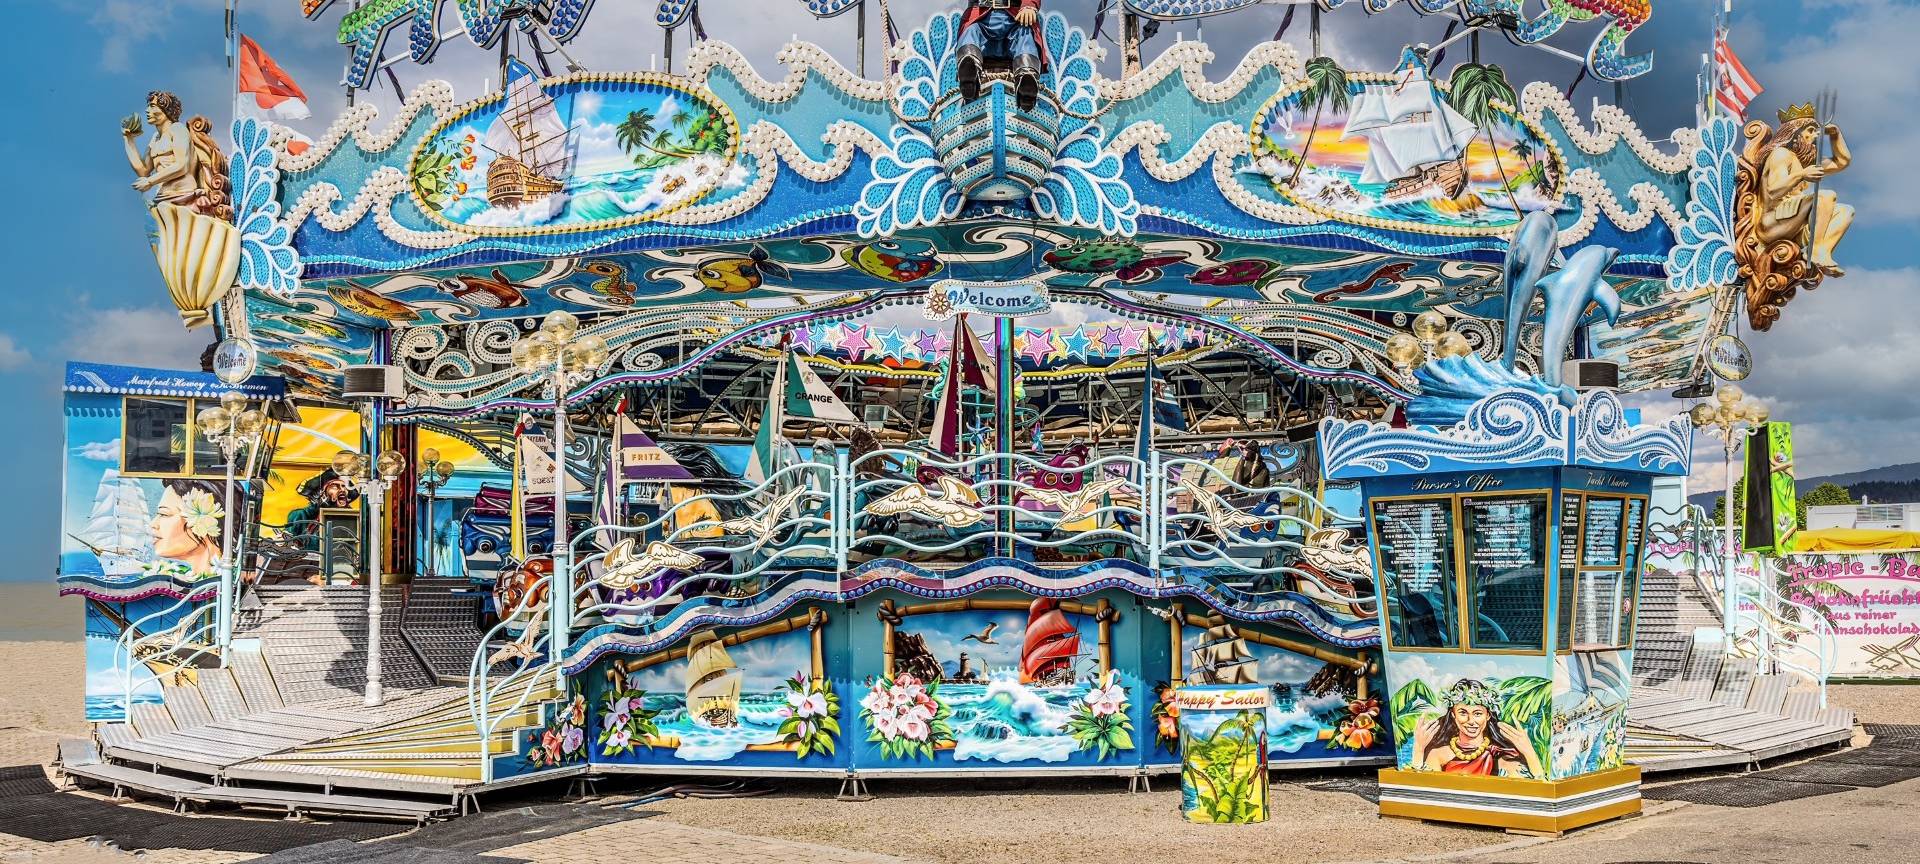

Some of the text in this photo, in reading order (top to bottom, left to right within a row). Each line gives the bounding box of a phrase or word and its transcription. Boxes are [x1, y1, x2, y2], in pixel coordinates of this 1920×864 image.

[948, 287, 1032, 307] Welcome
[217, 352, 247, 369] Welcome
[1714, 346, 1748, 368] Welcome
[127, 375, 170, 389] Manfred
[631, 453, 661, 462] FRITZ
[1465, 473, 1504, 492] Office
[1786, 561, 1865, 581] Tropic
[1854, 609, 1897, 620] reiner
[1220, 690, 1265, 706] Sailor
